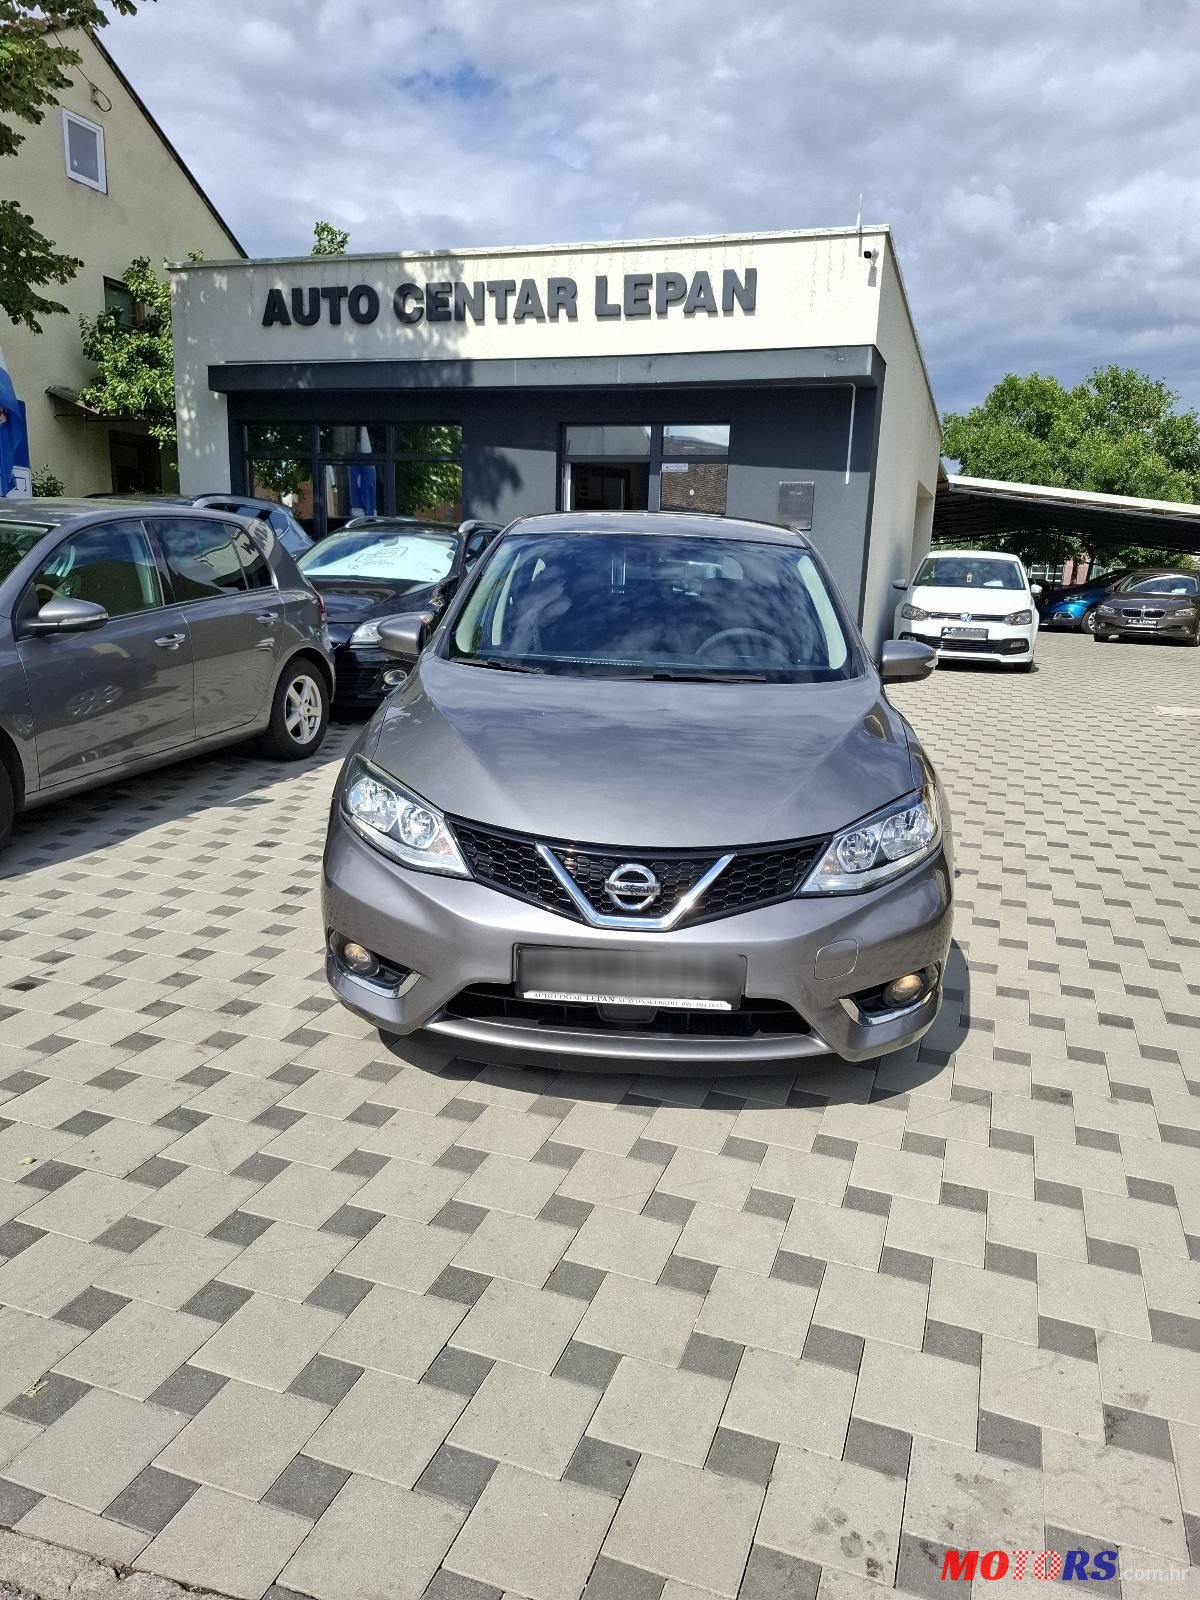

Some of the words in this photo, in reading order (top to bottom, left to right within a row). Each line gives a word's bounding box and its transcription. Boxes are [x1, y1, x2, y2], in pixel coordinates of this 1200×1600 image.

[261, 284, 380, 327] AUTO
[392, 277, 579, 324] CENTAR
[594, 267, 758, 317] LEPAN
